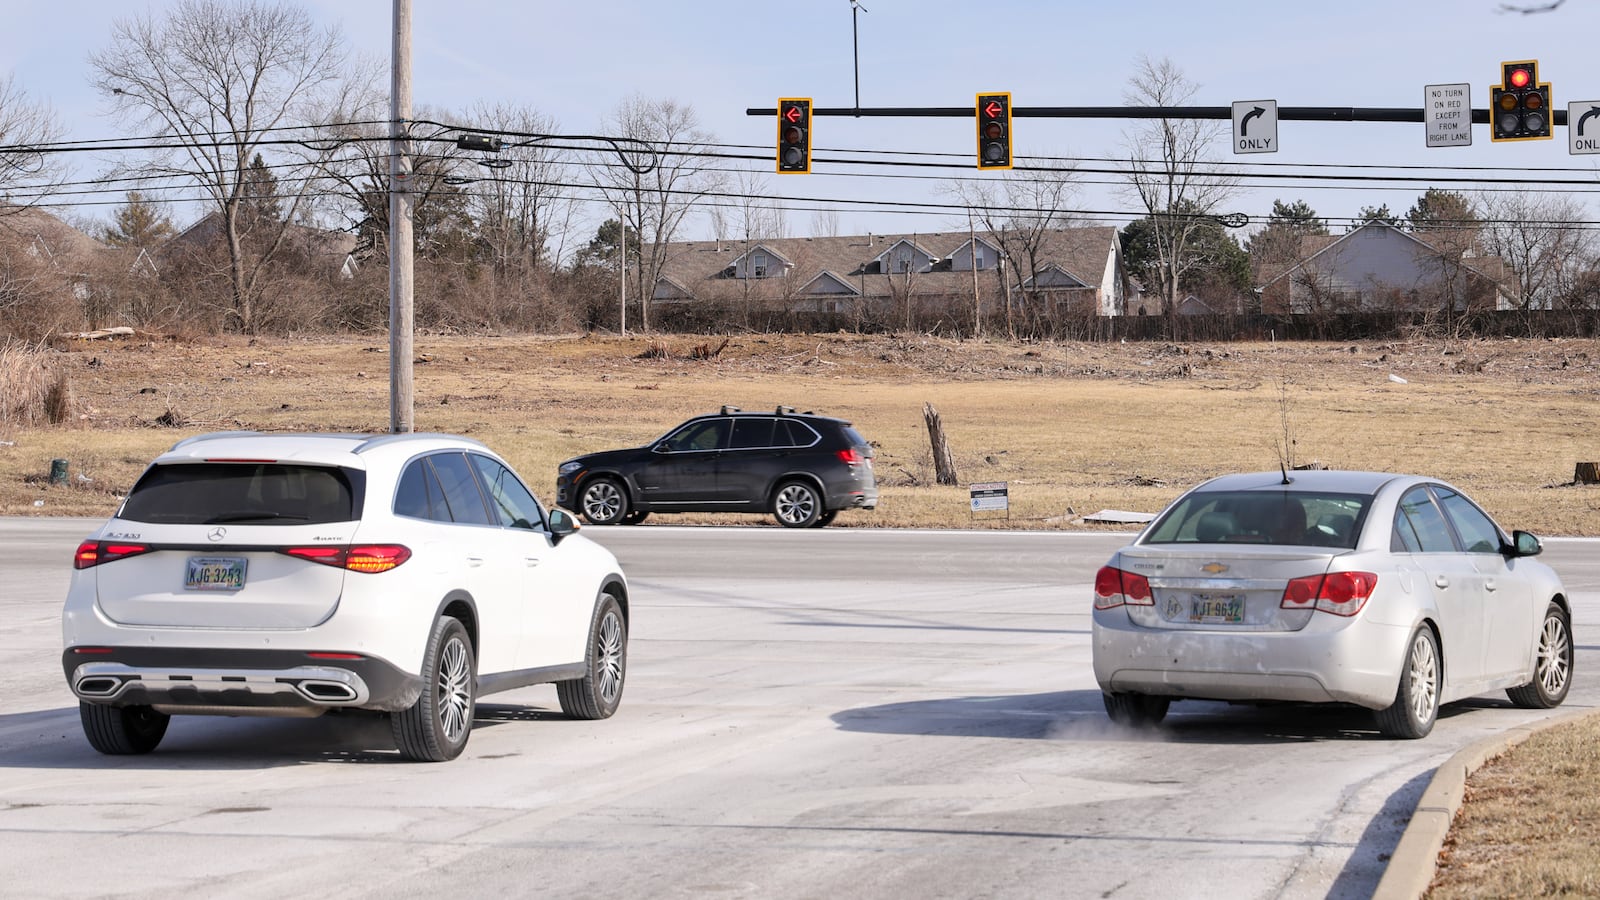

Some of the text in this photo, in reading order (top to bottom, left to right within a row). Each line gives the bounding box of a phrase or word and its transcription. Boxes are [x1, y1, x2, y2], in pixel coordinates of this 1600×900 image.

[1240, 138, 1271, 150] ONLY
[1576, 139, 1600, 150] ONL
[189, 568, 241, 583] KJG 3253
[1193, 602, 1211, 617] KJT
[1215, 602, 1240, 617] 9632
